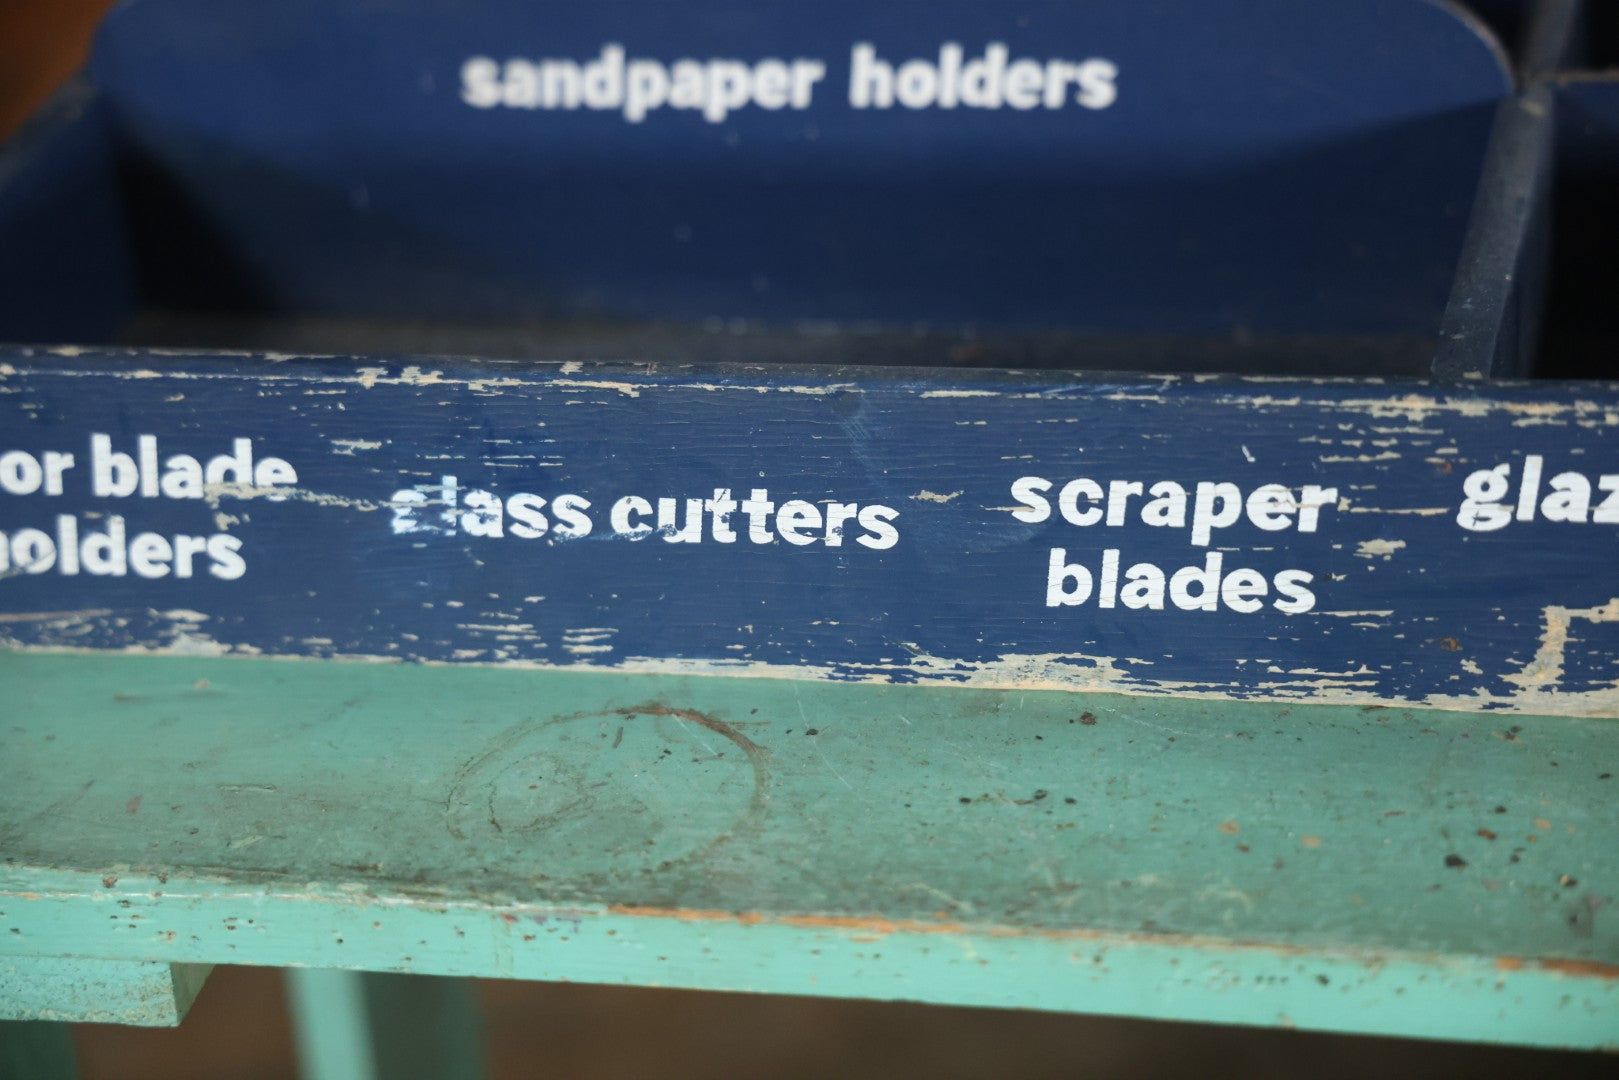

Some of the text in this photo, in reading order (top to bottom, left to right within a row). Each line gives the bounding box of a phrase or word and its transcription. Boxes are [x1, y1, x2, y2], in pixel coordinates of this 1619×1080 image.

[460, 43, 1118, 122] sandpaper holders
[91, 432, 298, 501] blade
[611, 488, 899, 550] cutters
[1011, 476, 1338, 546] scraper
[0, 514, 247, 580] olders
[1046, 548, 1316, 614] blades
